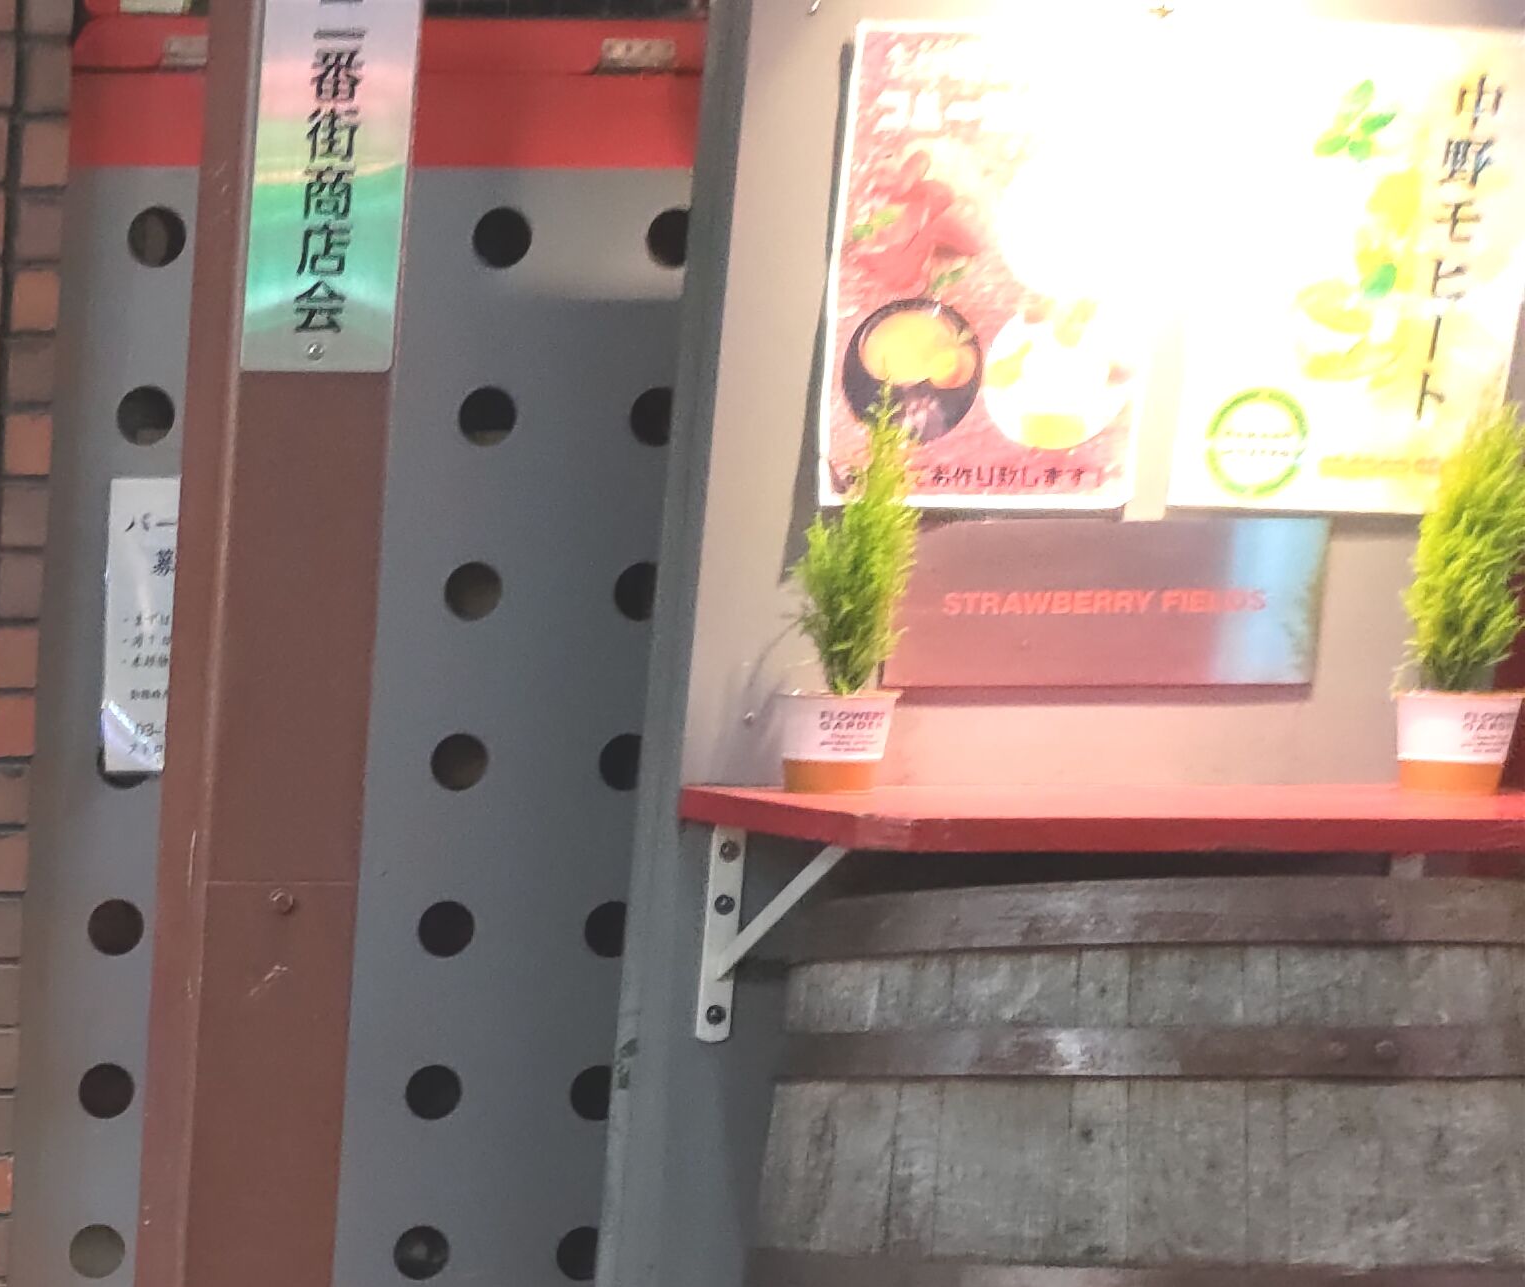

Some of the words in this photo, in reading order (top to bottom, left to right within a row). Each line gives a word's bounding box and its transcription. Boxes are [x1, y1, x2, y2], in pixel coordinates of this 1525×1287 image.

[1417, 72, 1507, 421] 中野モヒート
[942, 589, 1153, 616] STRAWBERRY
[1161, 588, 1268, 615] FIELDS
